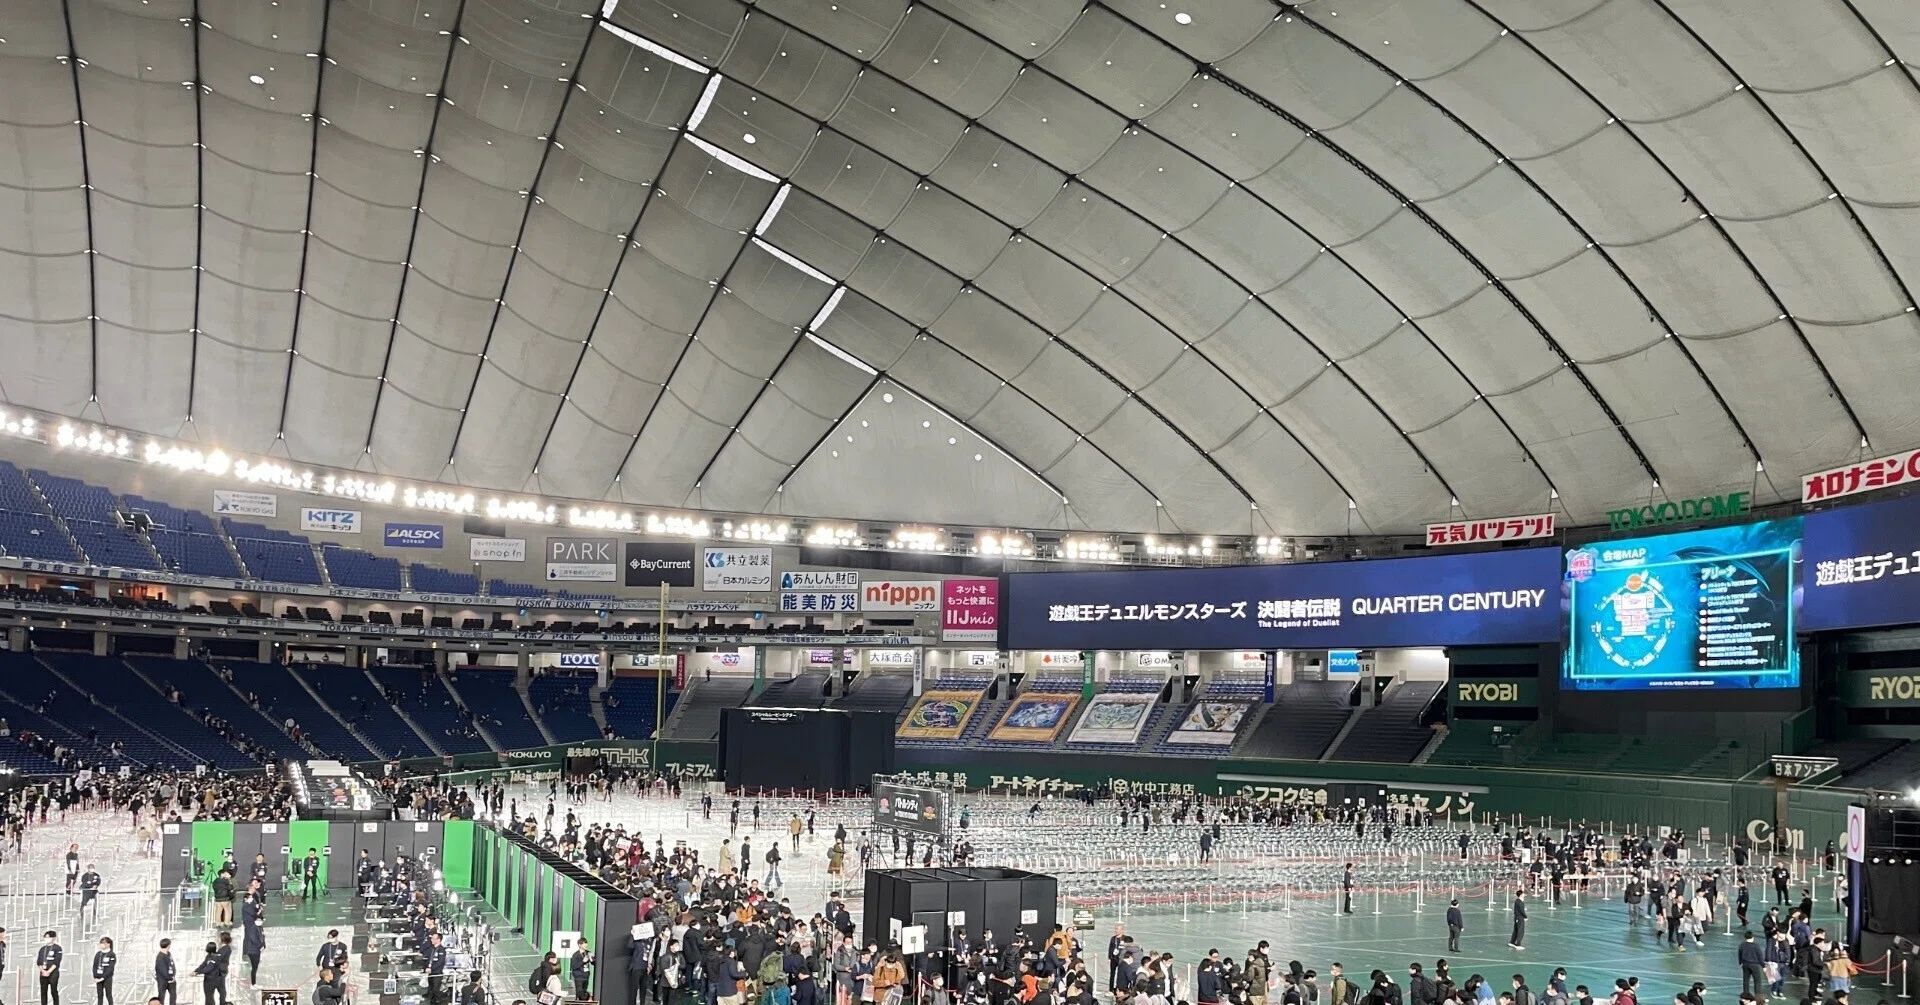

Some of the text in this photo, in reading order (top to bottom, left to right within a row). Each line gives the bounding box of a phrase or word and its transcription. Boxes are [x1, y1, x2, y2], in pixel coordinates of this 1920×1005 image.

[308, 511, 354, 524] KITZ
[1606, 491, 1750, 532] TOKYO DOME
[399, 529, 440, 540] ALSOK
[1429, 516, 1553, 544] 元気ハツラツ!
[482, 549, 510, 558] shop
[726, 554, 770, 566] 共立製薬
[640, 559, 692, 572] BayCurrent
[1700, 564, 1737, 581] アリーナ
[723, 576, 771, 585] 日本カルミック
[866, 583, 936, 606] nippn
[955, 585, 988, 594] ネットを
[516, 600, 551, 609] DUSKIN
[557, 601, 592, 609] DUSKIN
[686, 603, 740, 611] パラマウントベッド
[782, 593, 858, 611] 能美防災
[914, 602, 936, 610] ニップン
[946, 596, 996, 606] もっと快適に
[1257, 588, 1546, 619] 決闘者伝説 QUARTER CENTURY
[946, 609, 995, 626] IIJmio
[1048, 601, 1248, 622] 遊戯王デュエルモンスターズ
[1258, 620, 1271, 628] The
[1273, 619, 1301, 629] Legend
[1302, 619, 1311, 627] of
[870, 652, 913, 664] 大塚商会
[1361, 663, 1371, 672] 16
[1458, 683, 1518, 701] RYOBI
[508, 751, 552, 759] KOKUYO
[566, 747, 650, 765] 最先端の THK
[989, 775, 1084, 792] アートネイチャー
[1131, 780, 1195, 796] 竹中工務店
[1254, 785, 1328, 806] フコク生命
